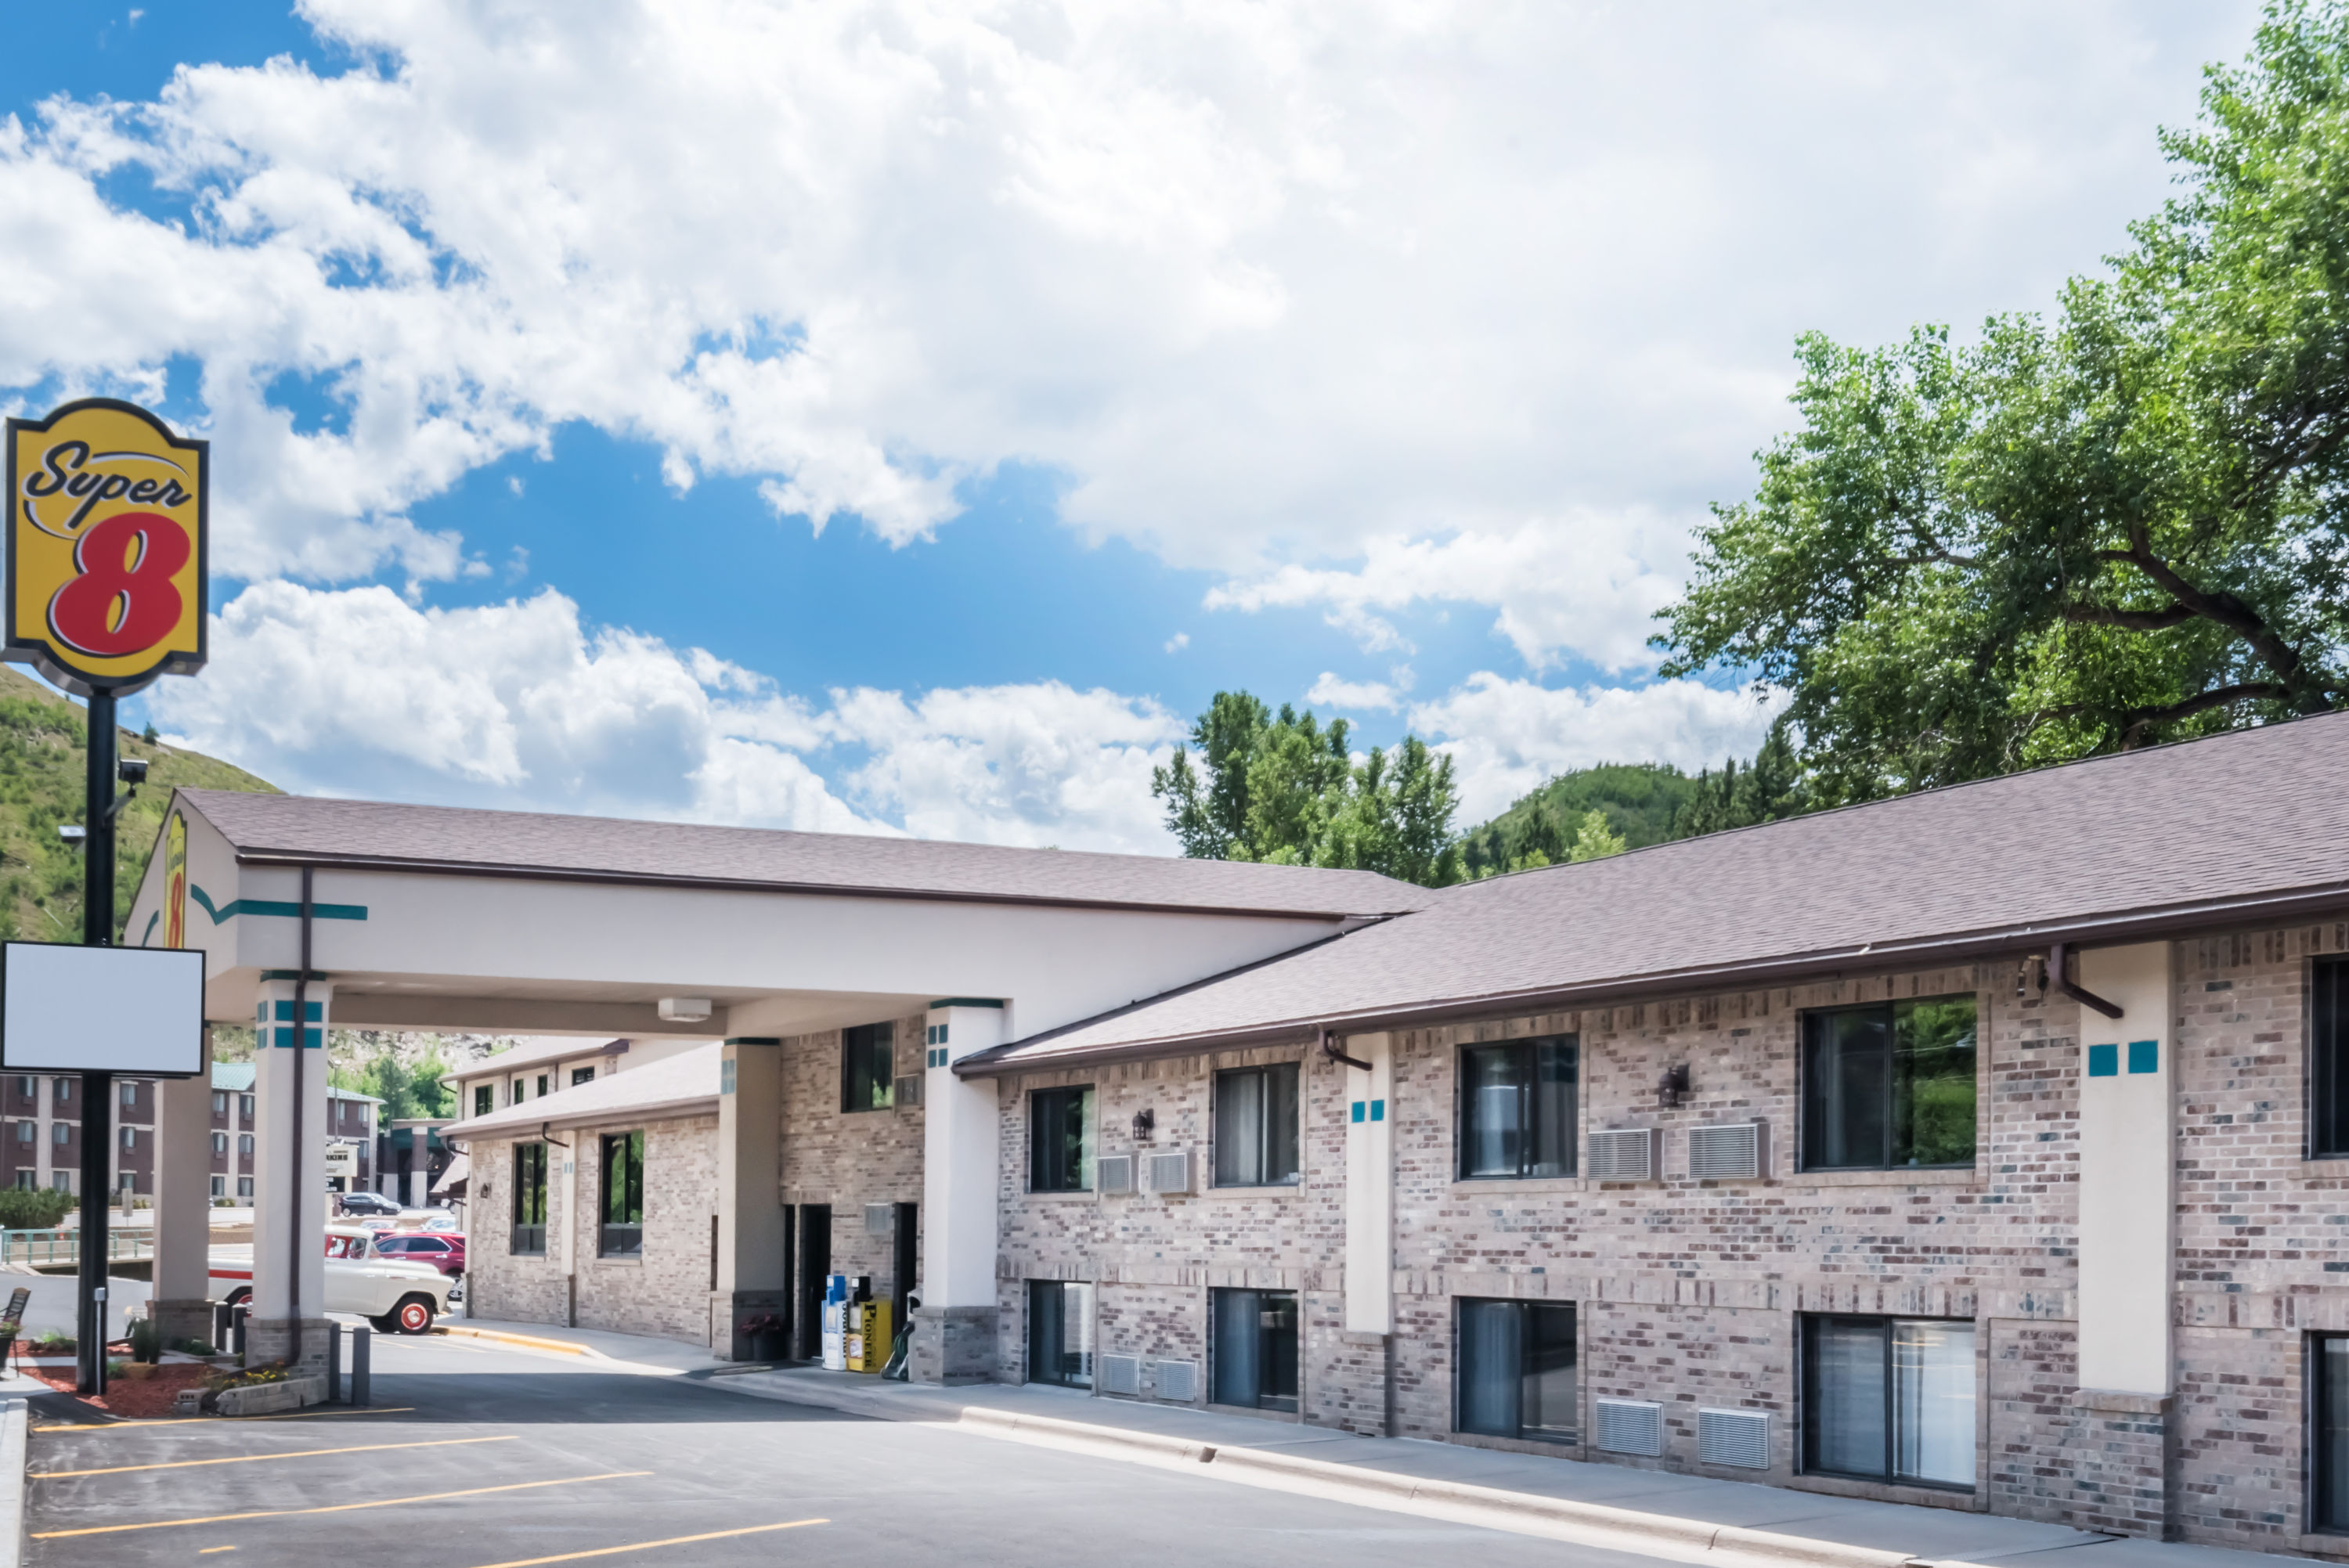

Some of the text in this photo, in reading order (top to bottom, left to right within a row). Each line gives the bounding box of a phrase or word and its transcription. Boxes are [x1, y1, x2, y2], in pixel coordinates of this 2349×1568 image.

[22, 440, 192, 530] Super
[46, 512, 190, 658] 8
[168, 872, 182, 948] 8
